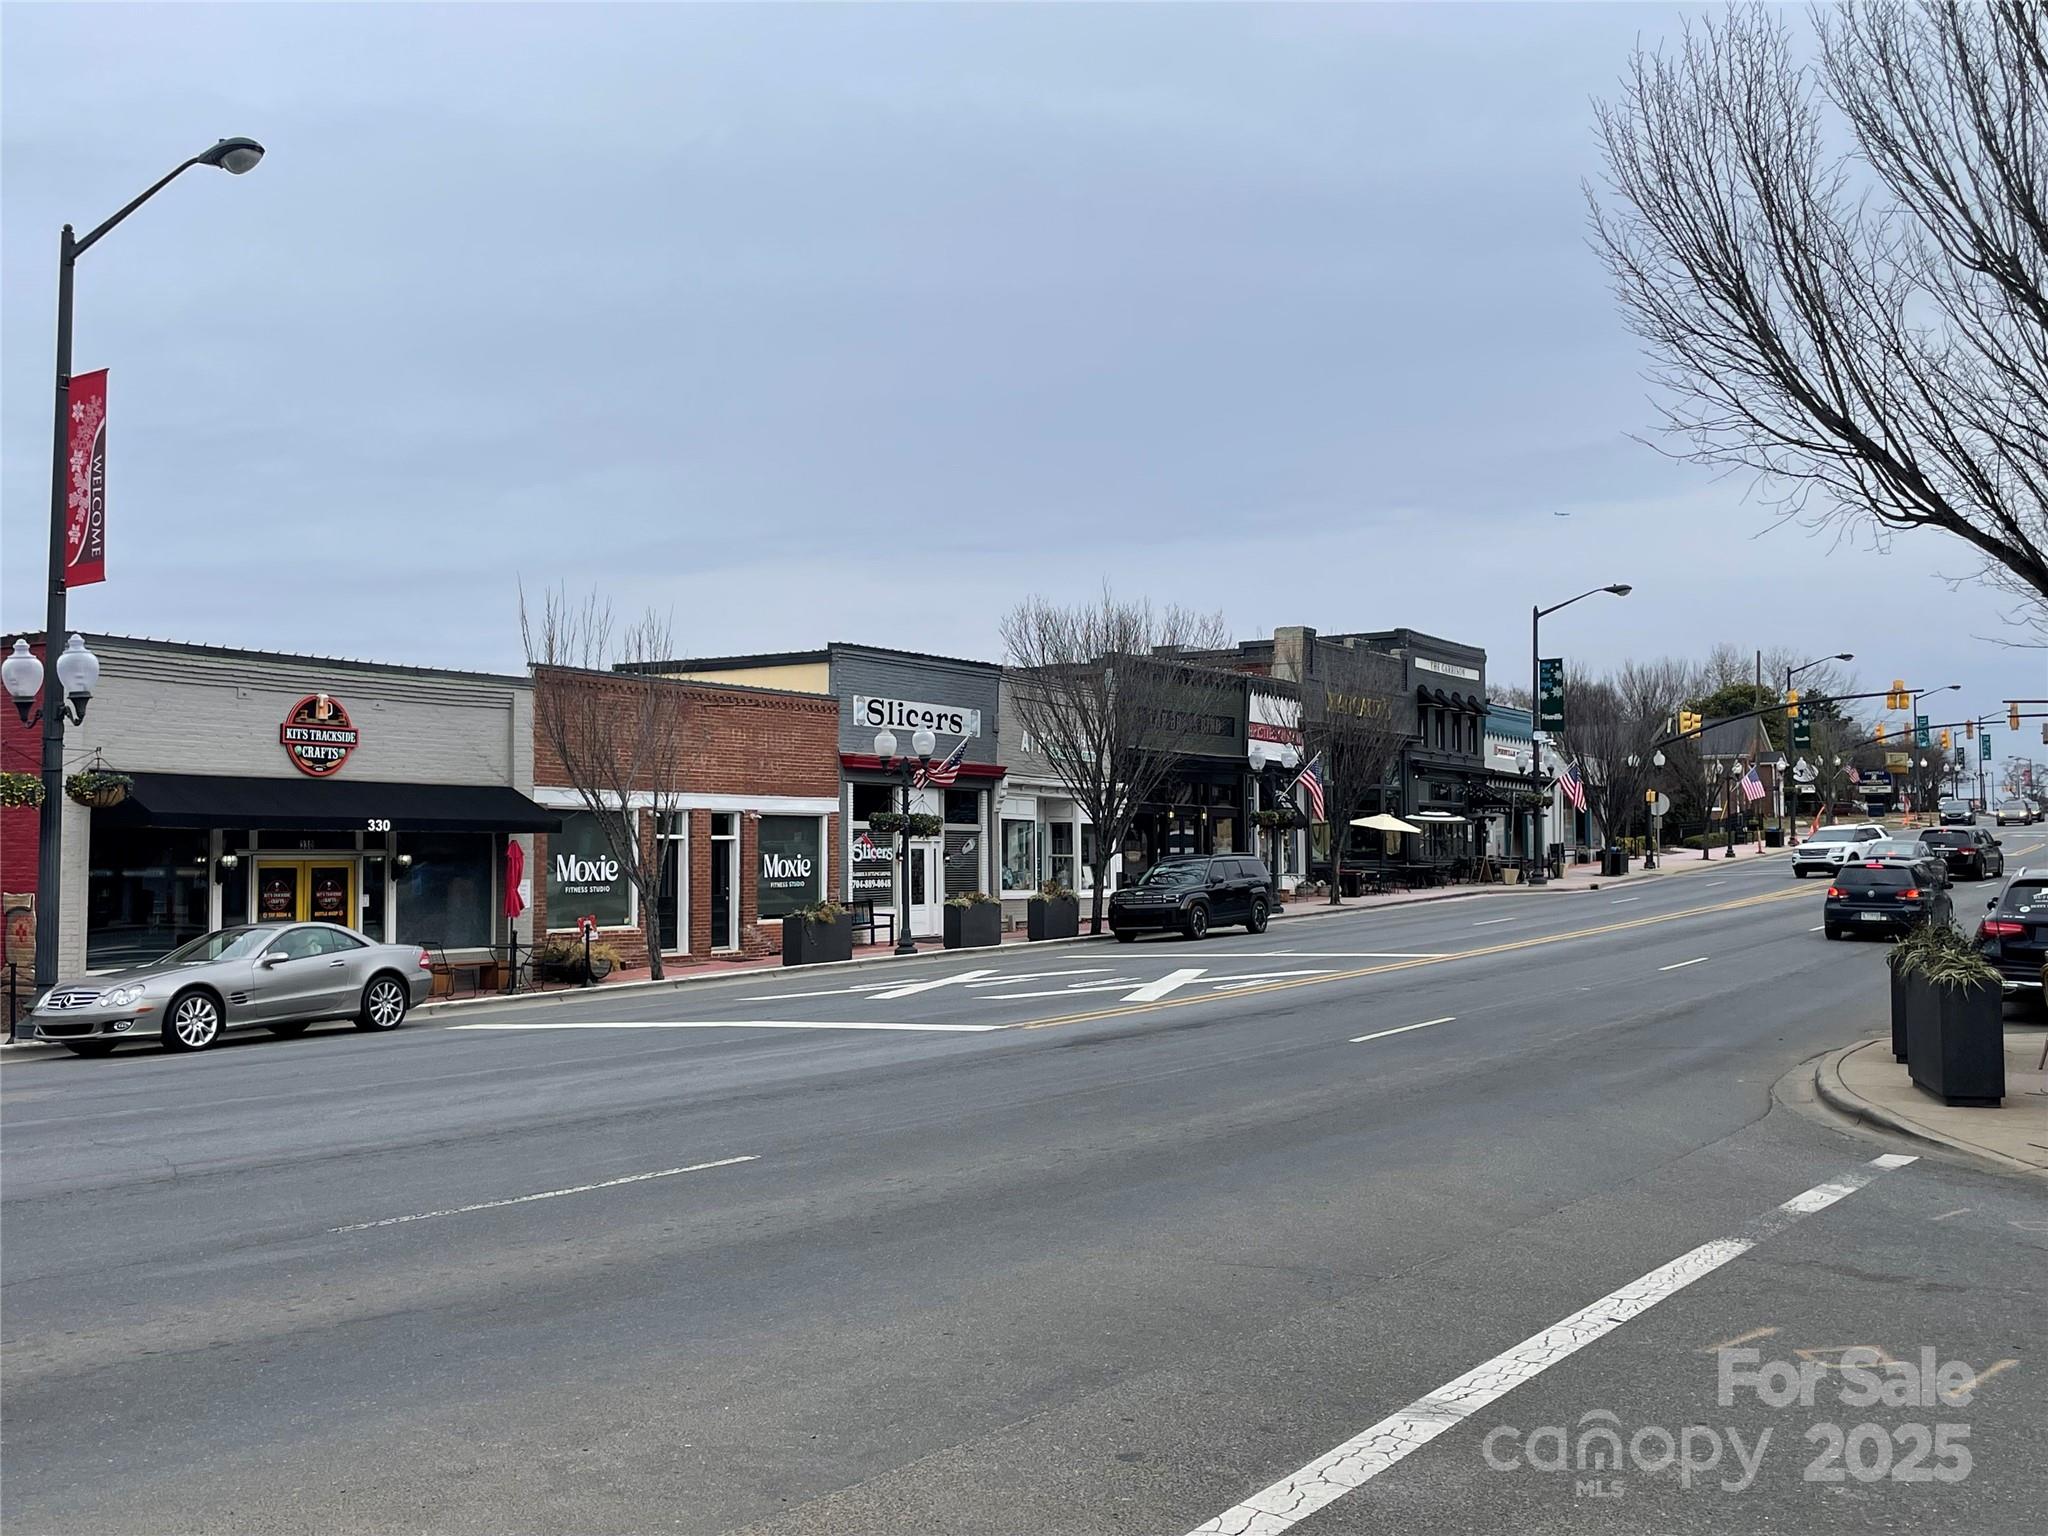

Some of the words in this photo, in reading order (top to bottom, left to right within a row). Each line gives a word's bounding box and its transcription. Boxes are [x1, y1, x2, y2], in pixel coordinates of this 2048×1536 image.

[91, 454, 103, 557] WELCOME
[867, 699, 963, 734] Slicers
[286, 728, 308, 740] KIT'S
[310, 729, 356, 743] TRACKSIDE
[302, 746, 338, 759] CRAFTS
[367, 819, 391, 831] 330
[852, 843, 893, 862] Slicers
[556, 854, 619, 882] Moxie
[763, 854, 811, 878] Moxie
